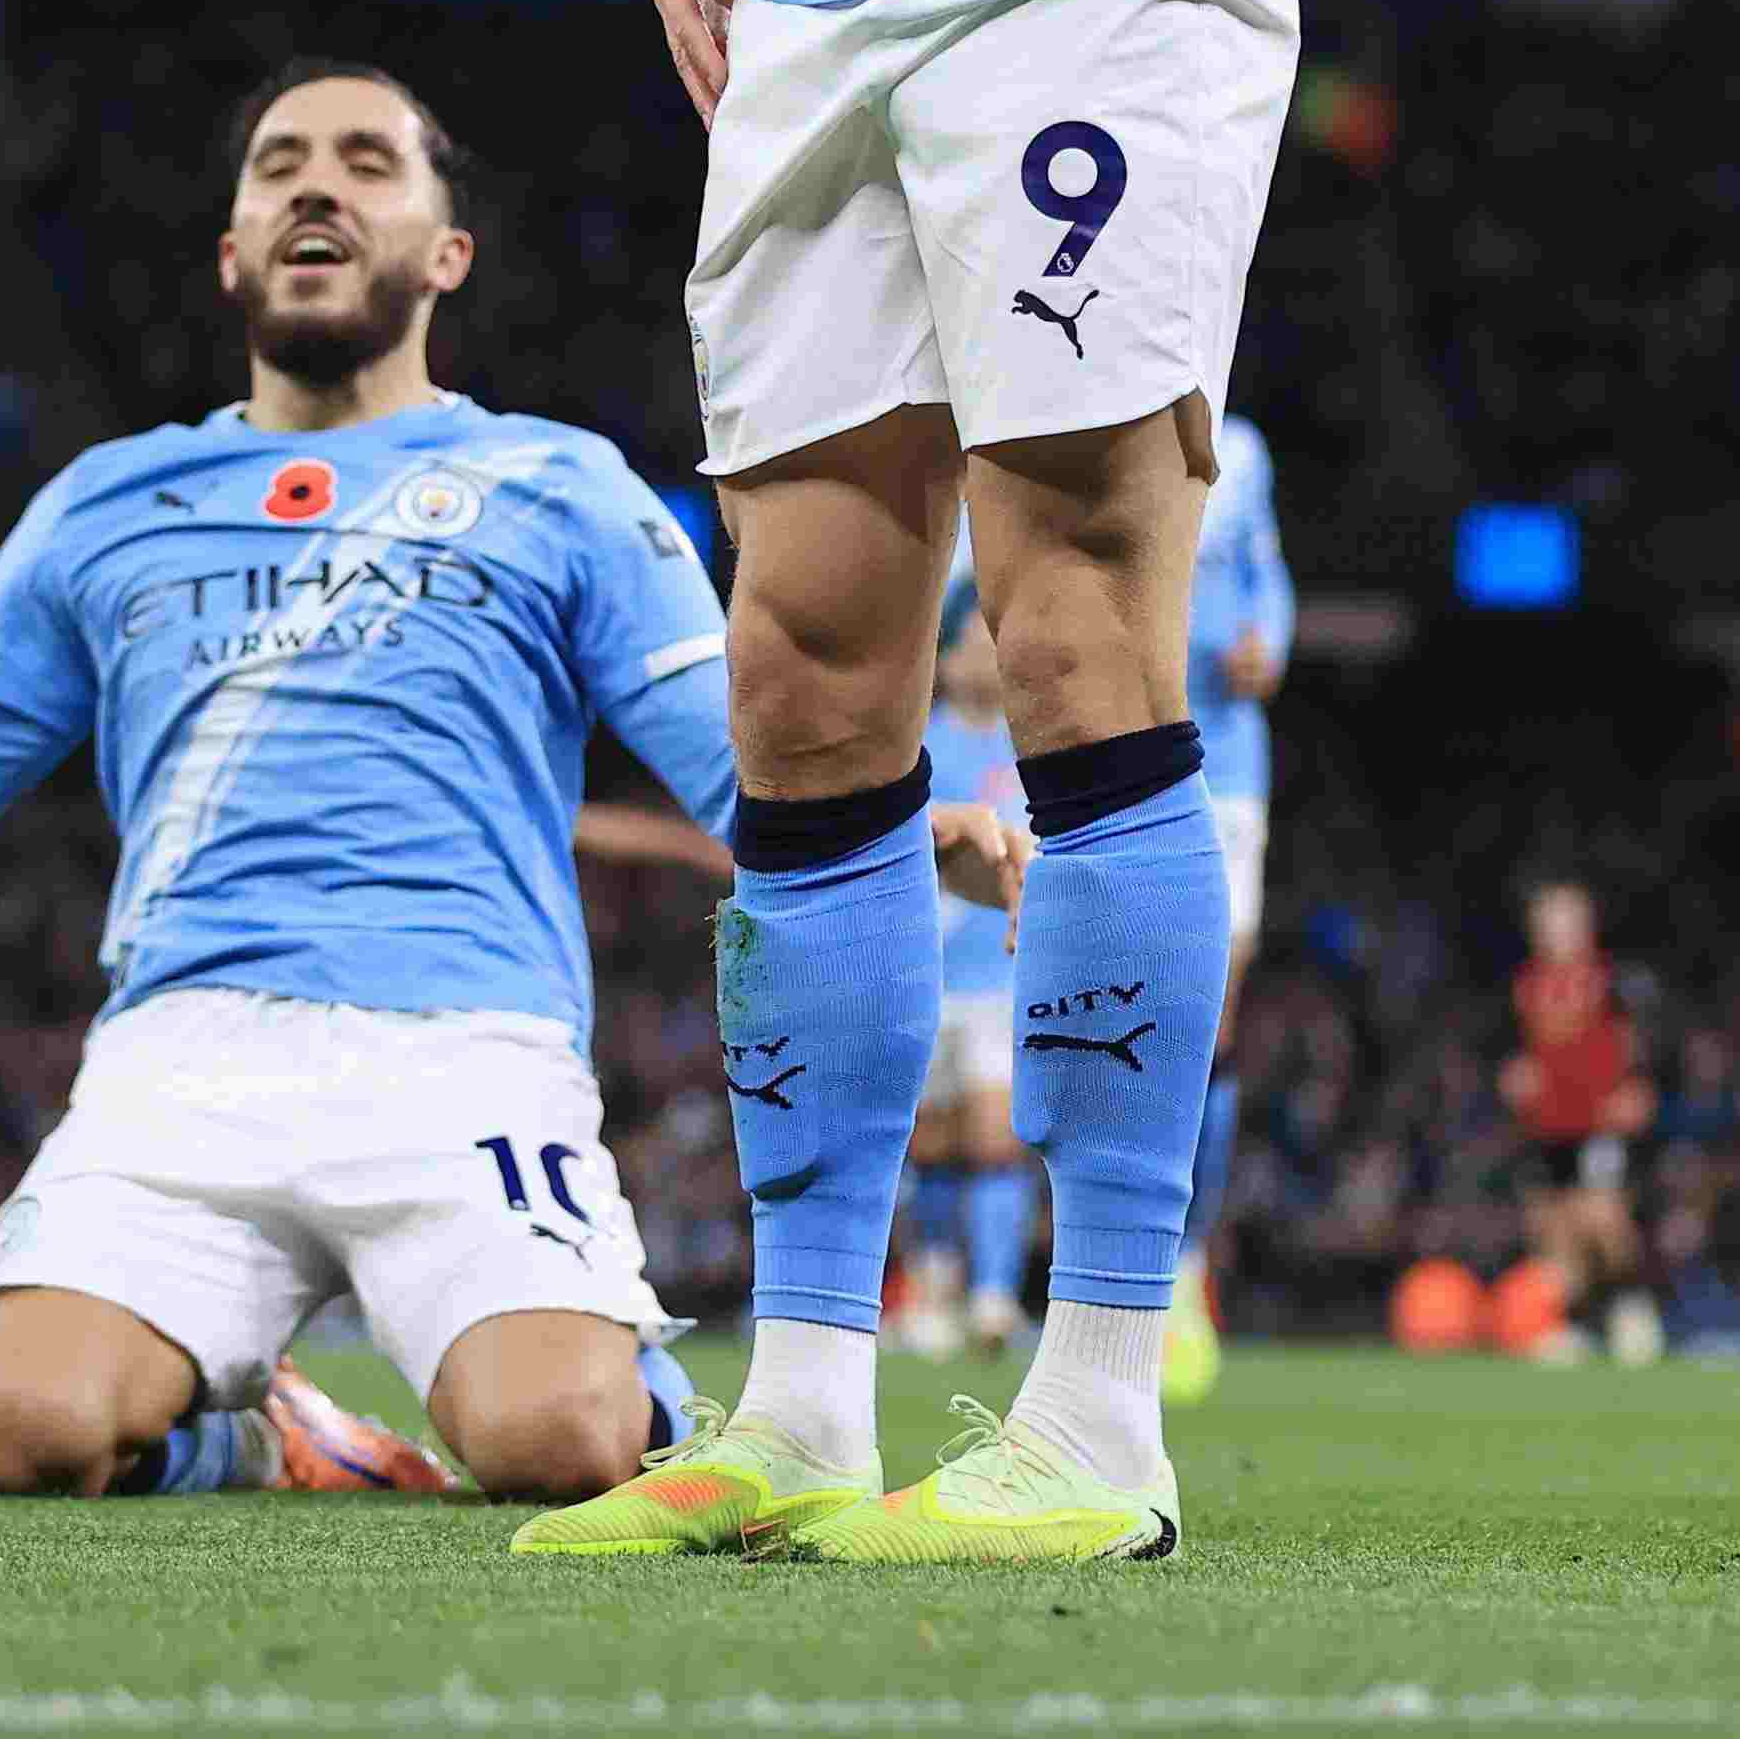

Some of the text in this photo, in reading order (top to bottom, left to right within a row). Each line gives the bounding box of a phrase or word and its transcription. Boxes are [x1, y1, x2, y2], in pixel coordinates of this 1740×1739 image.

[1020, 120, 1128, 277] 9
[121, 556, 494, 640] ETIHAD
[188, 617, 404, 671] AIRWAYS
